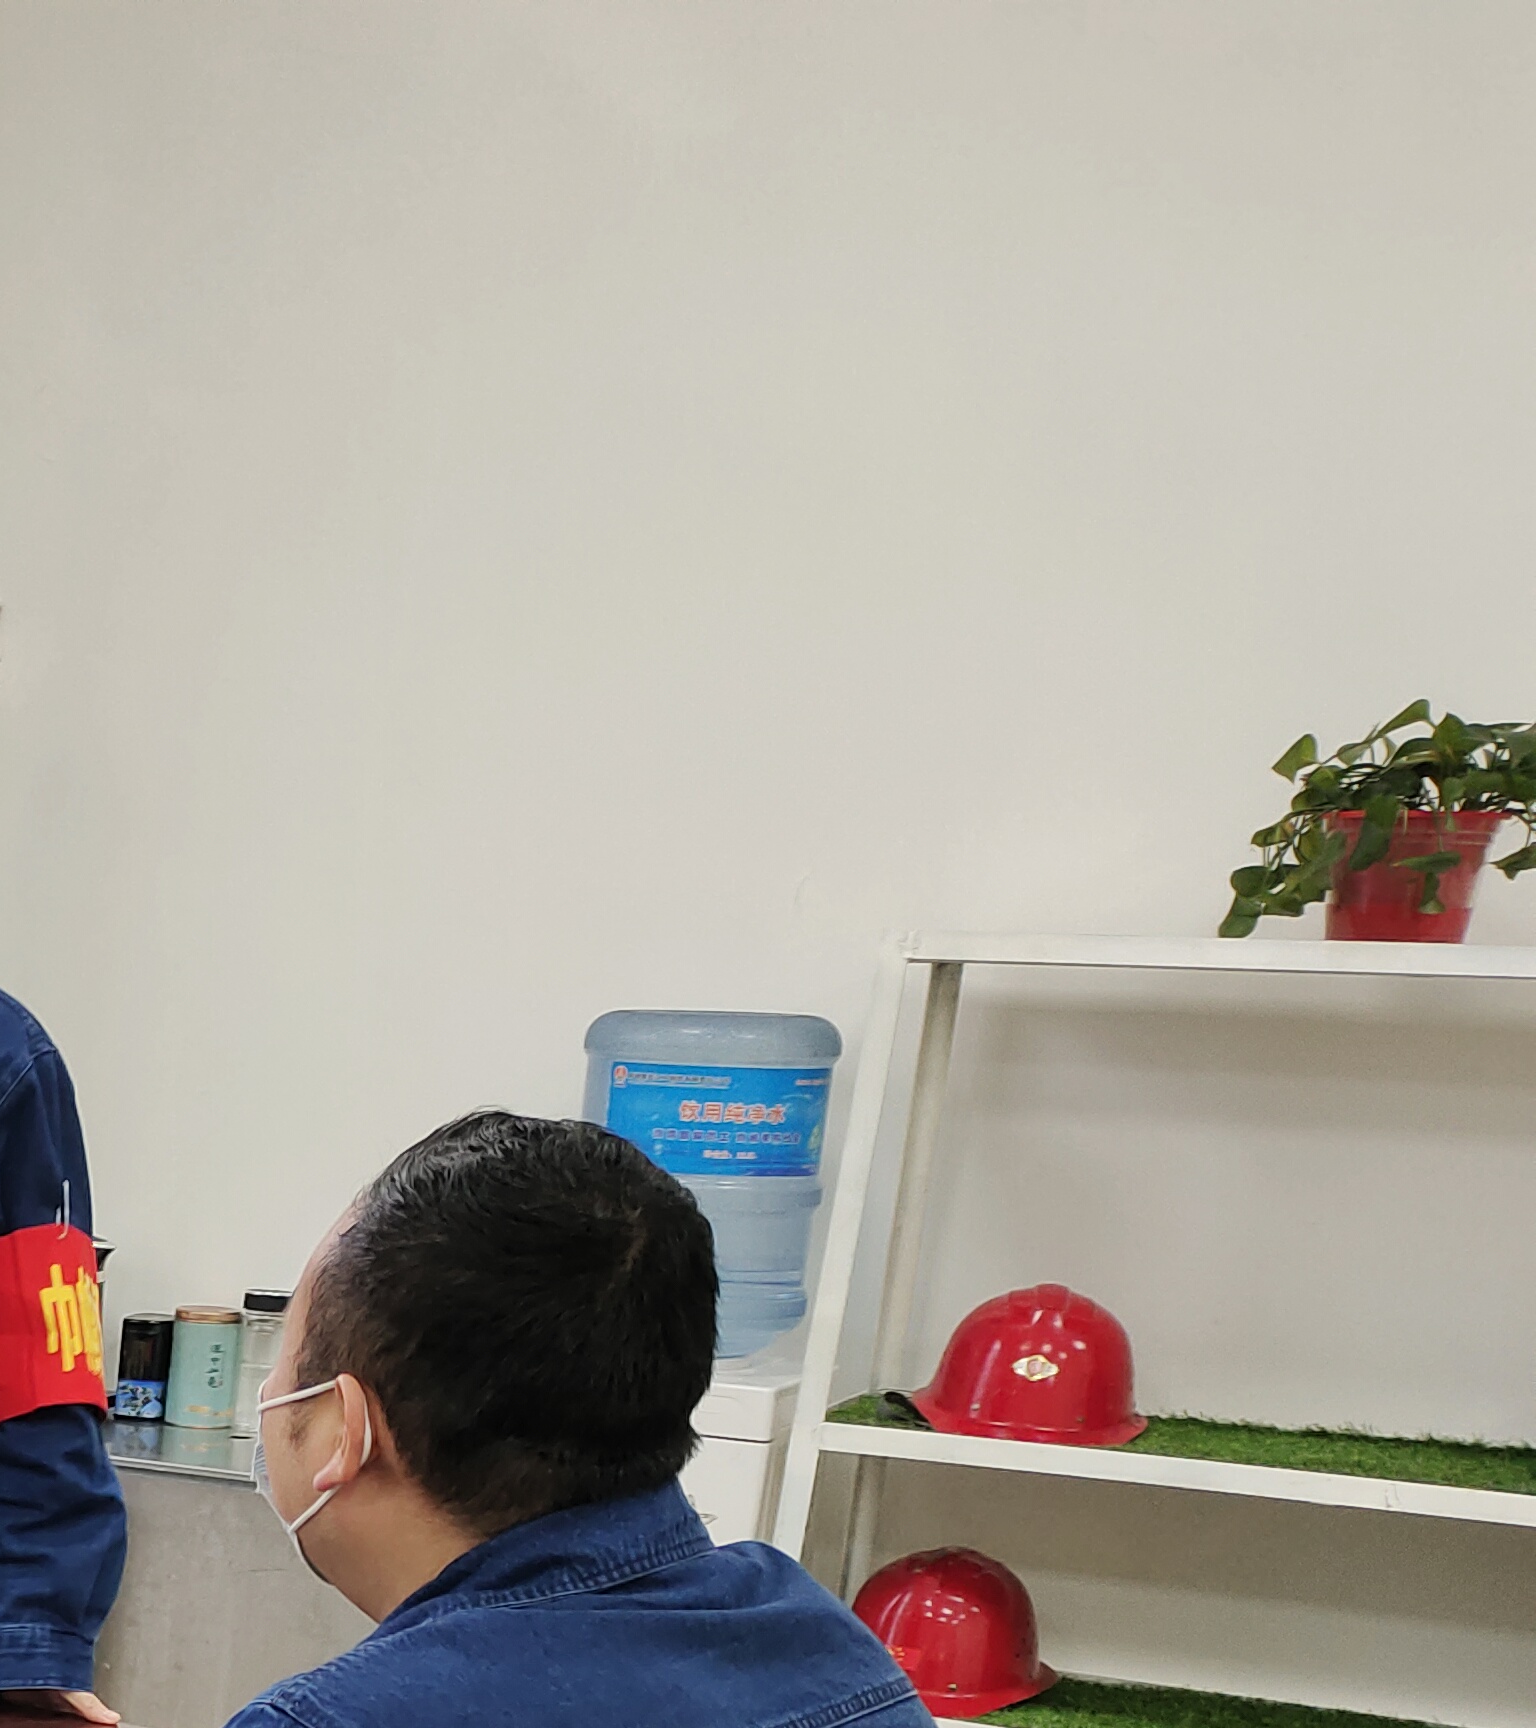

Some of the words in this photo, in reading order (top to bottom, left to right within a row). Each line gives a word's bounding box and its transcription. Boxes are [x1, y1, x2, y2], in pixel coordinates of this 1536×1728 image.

[679, 1100, 787, 1126] 饮用纯净水
